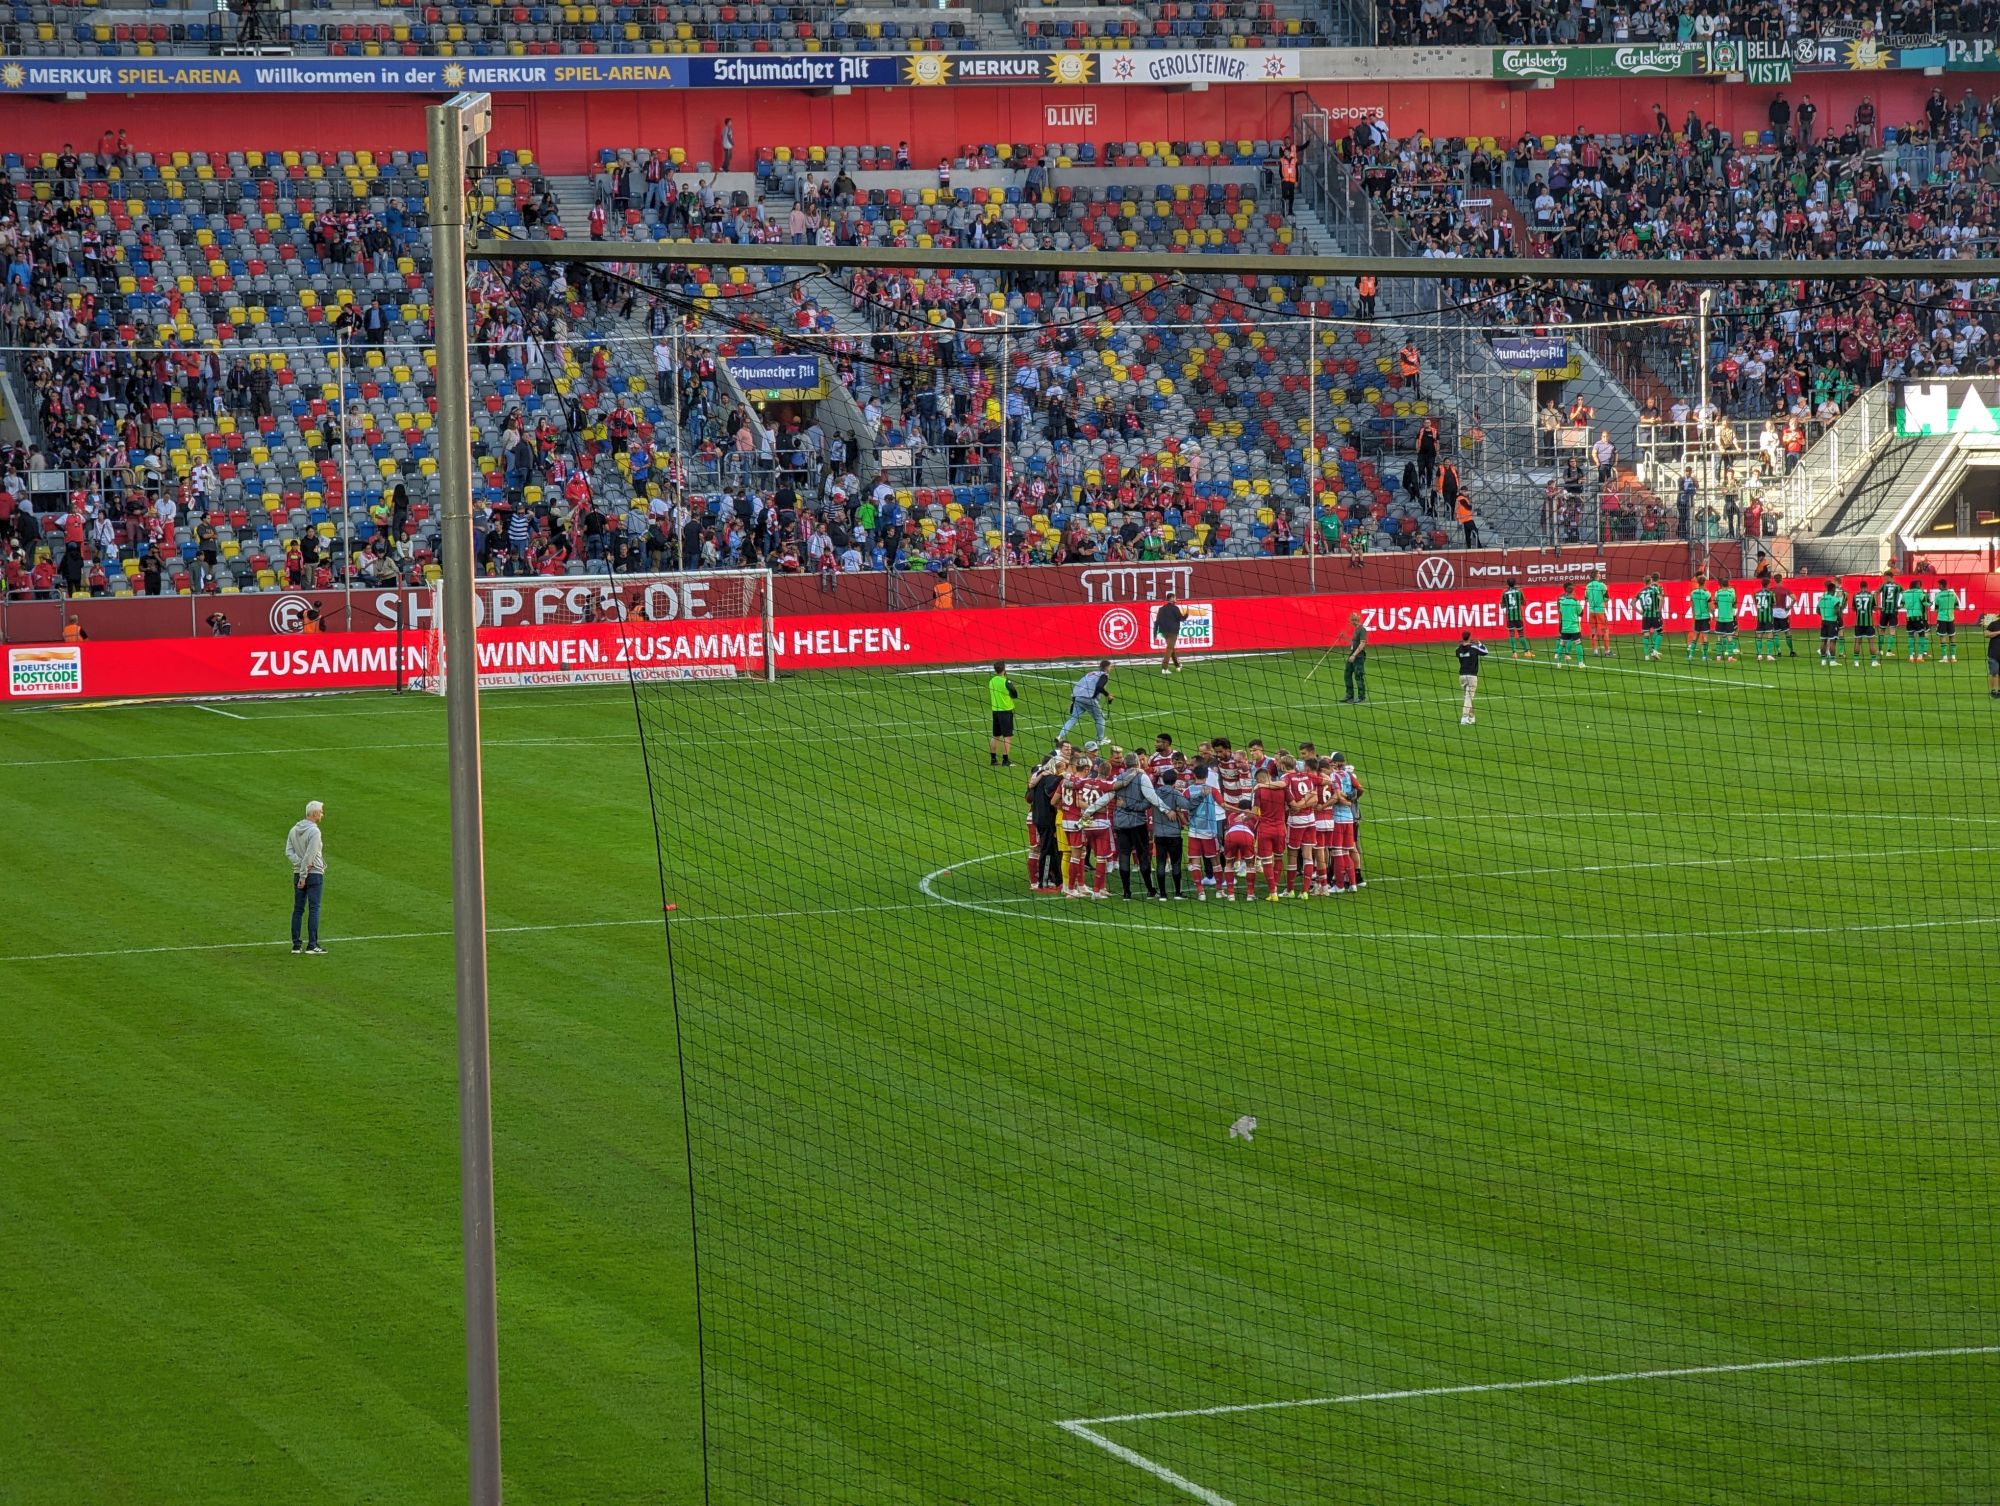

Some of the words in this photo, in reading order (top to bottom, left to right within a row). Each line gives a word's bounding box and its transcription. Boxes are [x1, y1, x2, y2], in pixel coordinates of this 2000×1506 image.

[1747, 41, 1791, 60] BELLA
[959, 59, 1040, 76] MERKUR
[1149, 52, 1247, 81] GEROLSTEINER
[1502, 50, 1567, 76] Carlsberg
[1615, 47, 1682, 74] Carlsberg
[30, 67, 113, 84] MERKUR
[118, 68, 242, 84] SPIEL-ARENA
[256, 67, 376, 84] Willkommen
[381, 67, 400, 84] in
[404, 66, 436, 84] der
[468, 67, 546, 83] MERKUR
[554, 66, 671, 82] SPIEL-ARENA
[713, 57, 834, 83] Schumacher
[839, 57, 869, 83] Alt
[1748, 62, 1792, 83] VISTA
[1047, 107, 1094, 126] D.LIVE
[730, 365, 796, 379] Schumacher
[798, 364, 815, 379] Alt
[1545, 368, 1556, 380] 19
[1469, 565, 1522, 576] MOLL
[1527, 562, 1606, 574] GRUPPE
[1550, 574, 1606, 582] PERFORMAE
[374, 583, 714, 631] SHP.F95DE
[1640, 593, 1651, 605] 16
[1757, 596, 1768, 608] 24
[1855, 597, 1869, 609] 37
[251, 646, 428, 676] ZUSAMMEN
[437, 639, 608, 670] WINNEN.
[616, 632, 785, 662] ZUSAMMEN
[794, 627, 911, 654] HELFEN.
[21, 663, 70, 671] DEUTSCHE
[13, 671, 78, 683] POSTCODE
[477, 676, 516, 686] TUELL
[524, 672, 570, 684] KÜCHEN
[574, 672, 624, 682] AKTUELL
[633, 670, 680, 680] KÜCHEN
[683, 667, 733, 678] AKTUELL
[21, 683, 71, 691] LOTTERIE
[1322, 785, 1331, 803] 6
